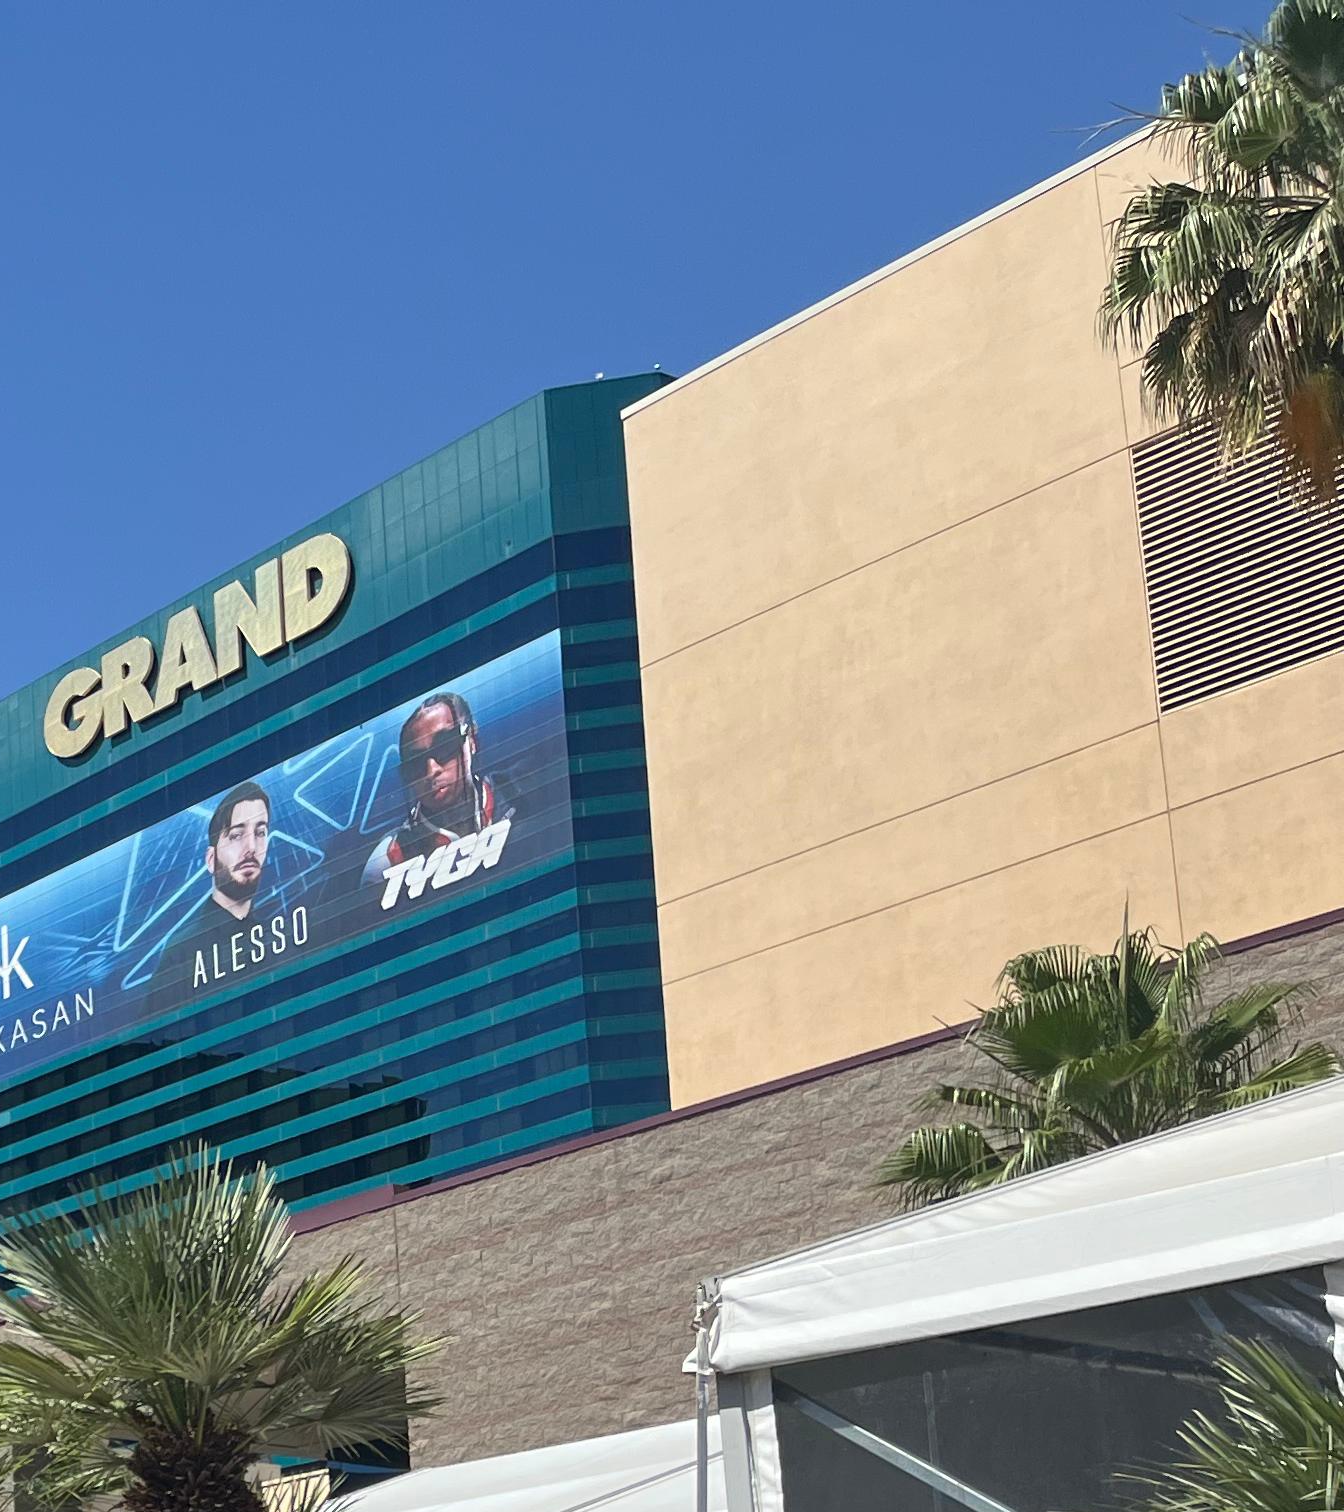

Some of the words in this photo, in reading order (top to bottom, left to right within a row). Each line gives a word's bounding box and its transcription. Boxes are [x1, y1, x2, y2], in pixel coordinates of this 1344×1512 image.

[43, 532, 354, 759] GRAND
[379, 819, 512, 911] TYGA
[192, 905, 309, 989] ALESSO
